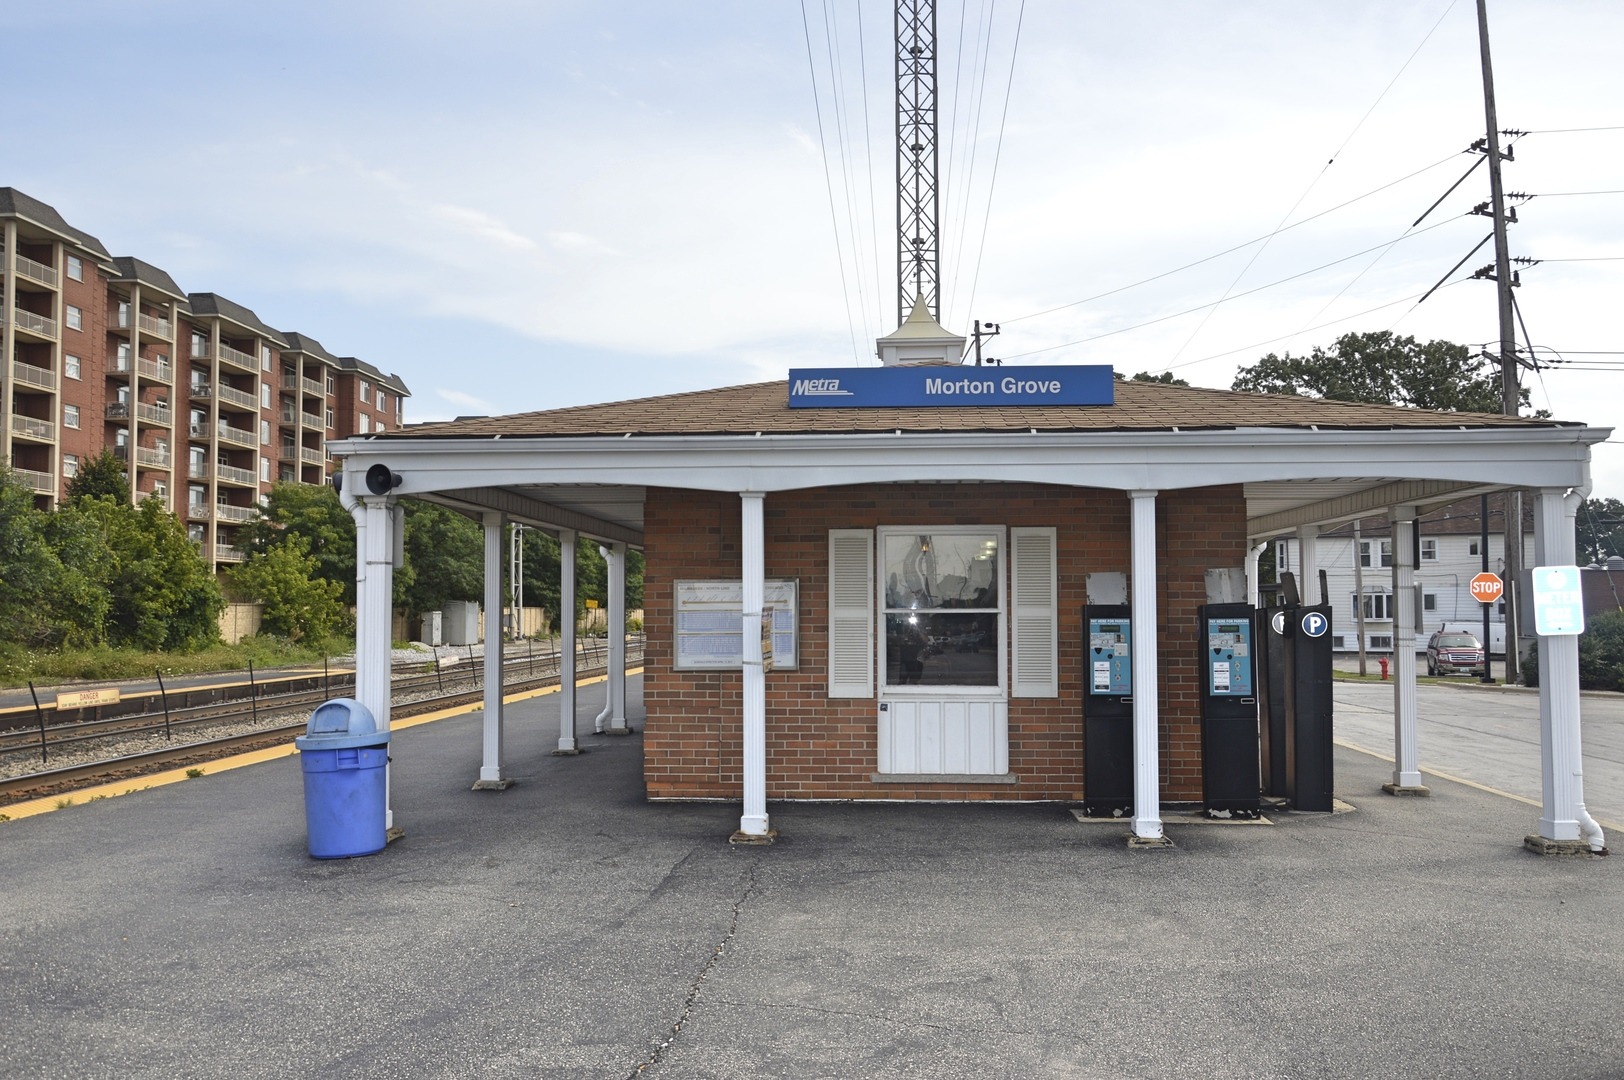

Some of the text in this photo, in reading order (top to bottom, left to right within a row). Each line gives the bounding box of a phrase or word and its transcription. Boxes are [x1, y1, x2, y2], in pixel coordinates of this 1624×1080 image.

[791, 378, 840, 396] Metra
[925, 377, 1061, 395] Morton Grove
[1472, 581, 1501, 594] STOP
[1310, 616, 1322, 633] P
[80, 692, 99, 701] DANGER
